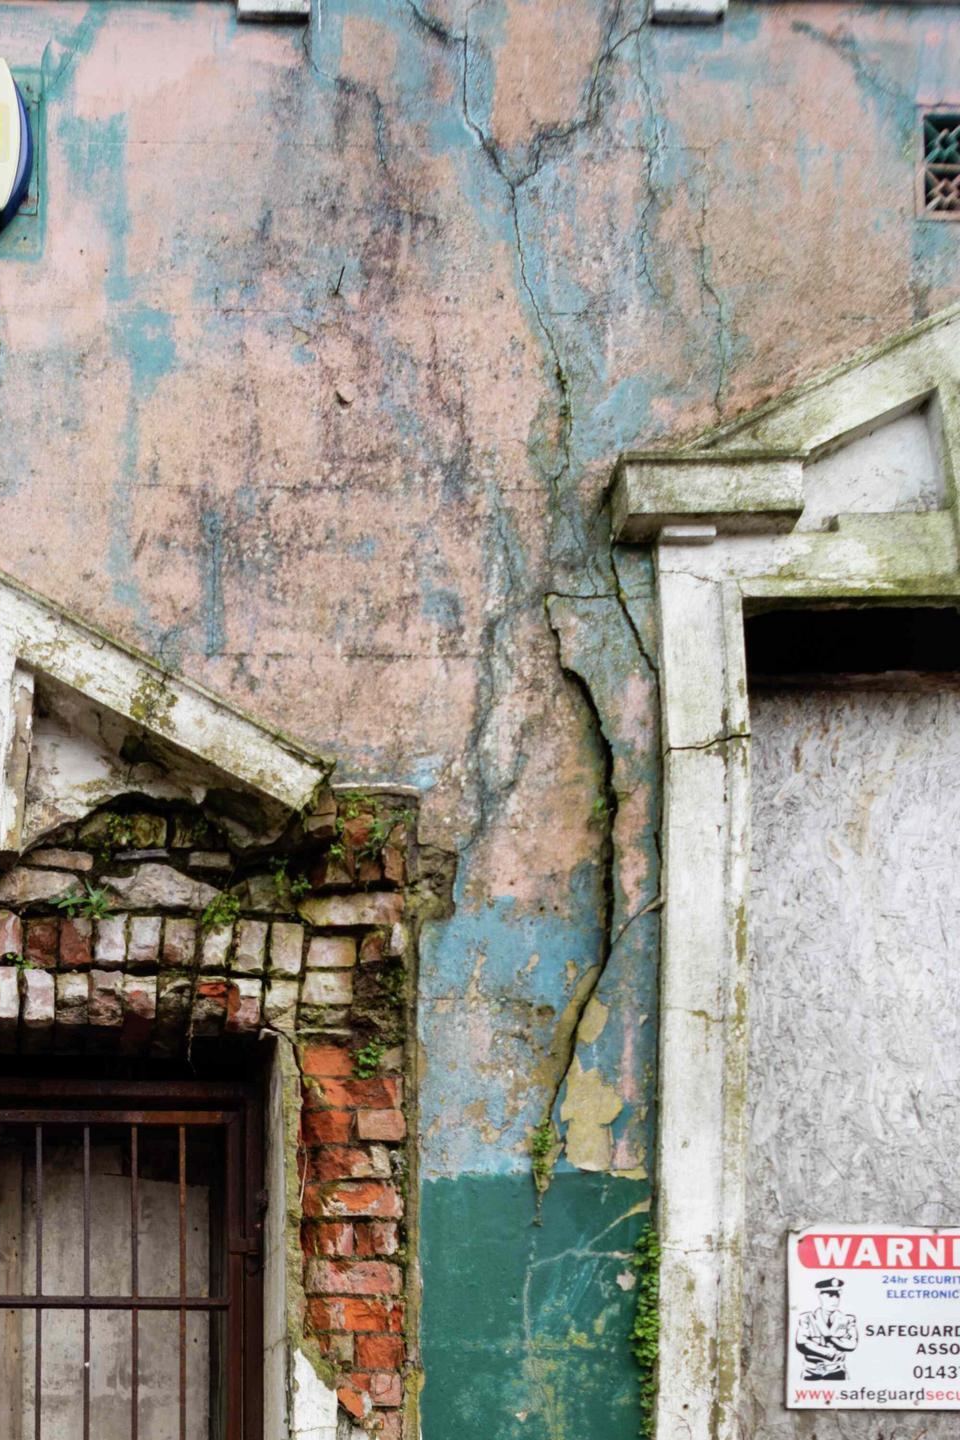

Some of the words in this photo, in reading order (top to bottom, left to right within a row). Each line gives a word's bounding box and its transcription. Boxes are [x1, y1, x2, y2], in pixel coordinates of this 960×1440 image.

[813, 1237, 960, 1267] WARNI
[882, 1275, 907, 1284] 24hr
[886, 1289, 960, 1299] ELECTRONIC
[916, 1343, 960, 1355] ASSO
[913, 1365, 960, 1379] 0143
